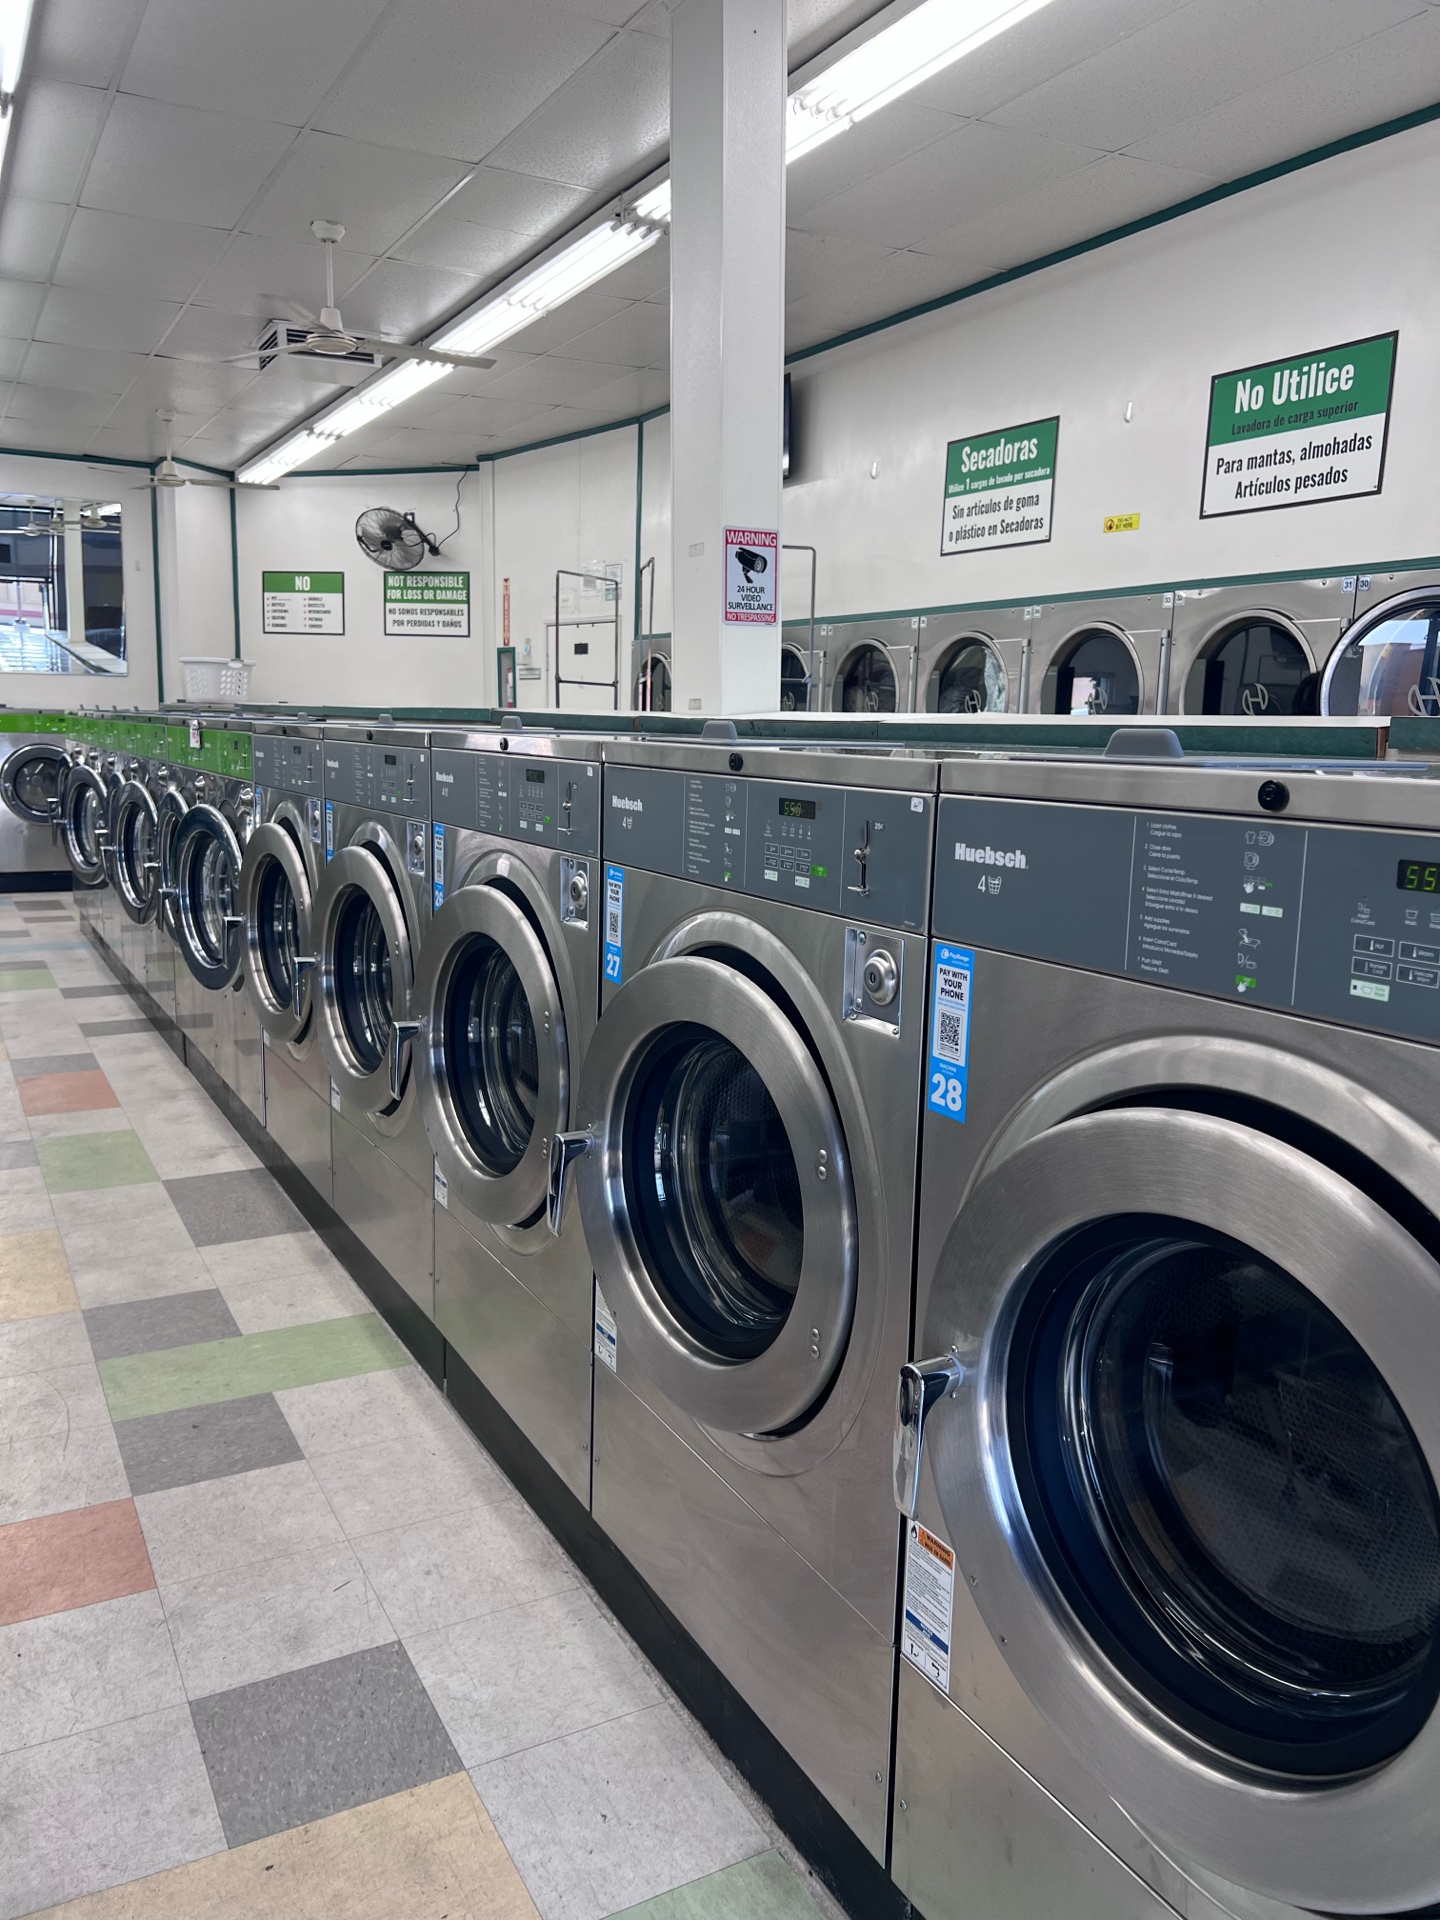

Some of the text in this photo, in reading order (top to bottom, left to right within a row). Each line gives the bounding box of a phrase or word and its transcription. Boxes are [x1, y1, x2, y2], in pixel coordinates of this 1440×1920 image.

[1234, 361, 1355, 414] No Utilice
[1231, 400, 1359, 436] Lavadora de carga superior
[961, 438, 1038, 473] Secadoras
[1216, 432, 1373, 475] Para mantas, almohadas
[948, 467, 1050, 494] Utilice 1 cargas de lavado por secadora
[1235, 465, 1348, 499] Artículos pesados
[952, 493, 1040, 520] Sin artículos de goma
[949, 515, 1044, 545] o plástico en Secadoras
[727, 531, 777, 547] WARNING
[294, 576, 311, 591] NO
[388, 575, 464, 588] NOT RESPONSIBLE
[1344, 581, 1352, 589] 31
[1359, 580, 1369, 588] 30
[387, 589, 468, 600] FOR LOSS OR DAMAGE
[736, 585, 766, 594] 24 HOUR
[741, 594, 761, 602] VIDEO
[420, 608, 464, 616] RESPONSABLES
[728, 601, 774, 611] SURVEILLANCE
[392, 618, 462, 628] POR PERDIDAS Y DAÑOS
[726, 612, 775, 623] NO TRESPASSING
[612, 795, 643, 812] Huebsch
[622, 816, 627, 829] 4
[874, 822, 884, 831] 25¢
[1162, 823, 1177, 831] clothes
[1149, 830, 1165, 838] Cargue
[954, 842, 1027, 869] Huebsch
[977, 875, 986, 893] 4
[606, 952, 620, 978] 27
[939, 967, 968, 981] PAY WITH
[943, 978, 963, 990] YOUR
[940, 987, 965, 1001] PHONE
[931, 1072, 963, 1112] 28
[926, 1533, 951, 1557] WARNING
